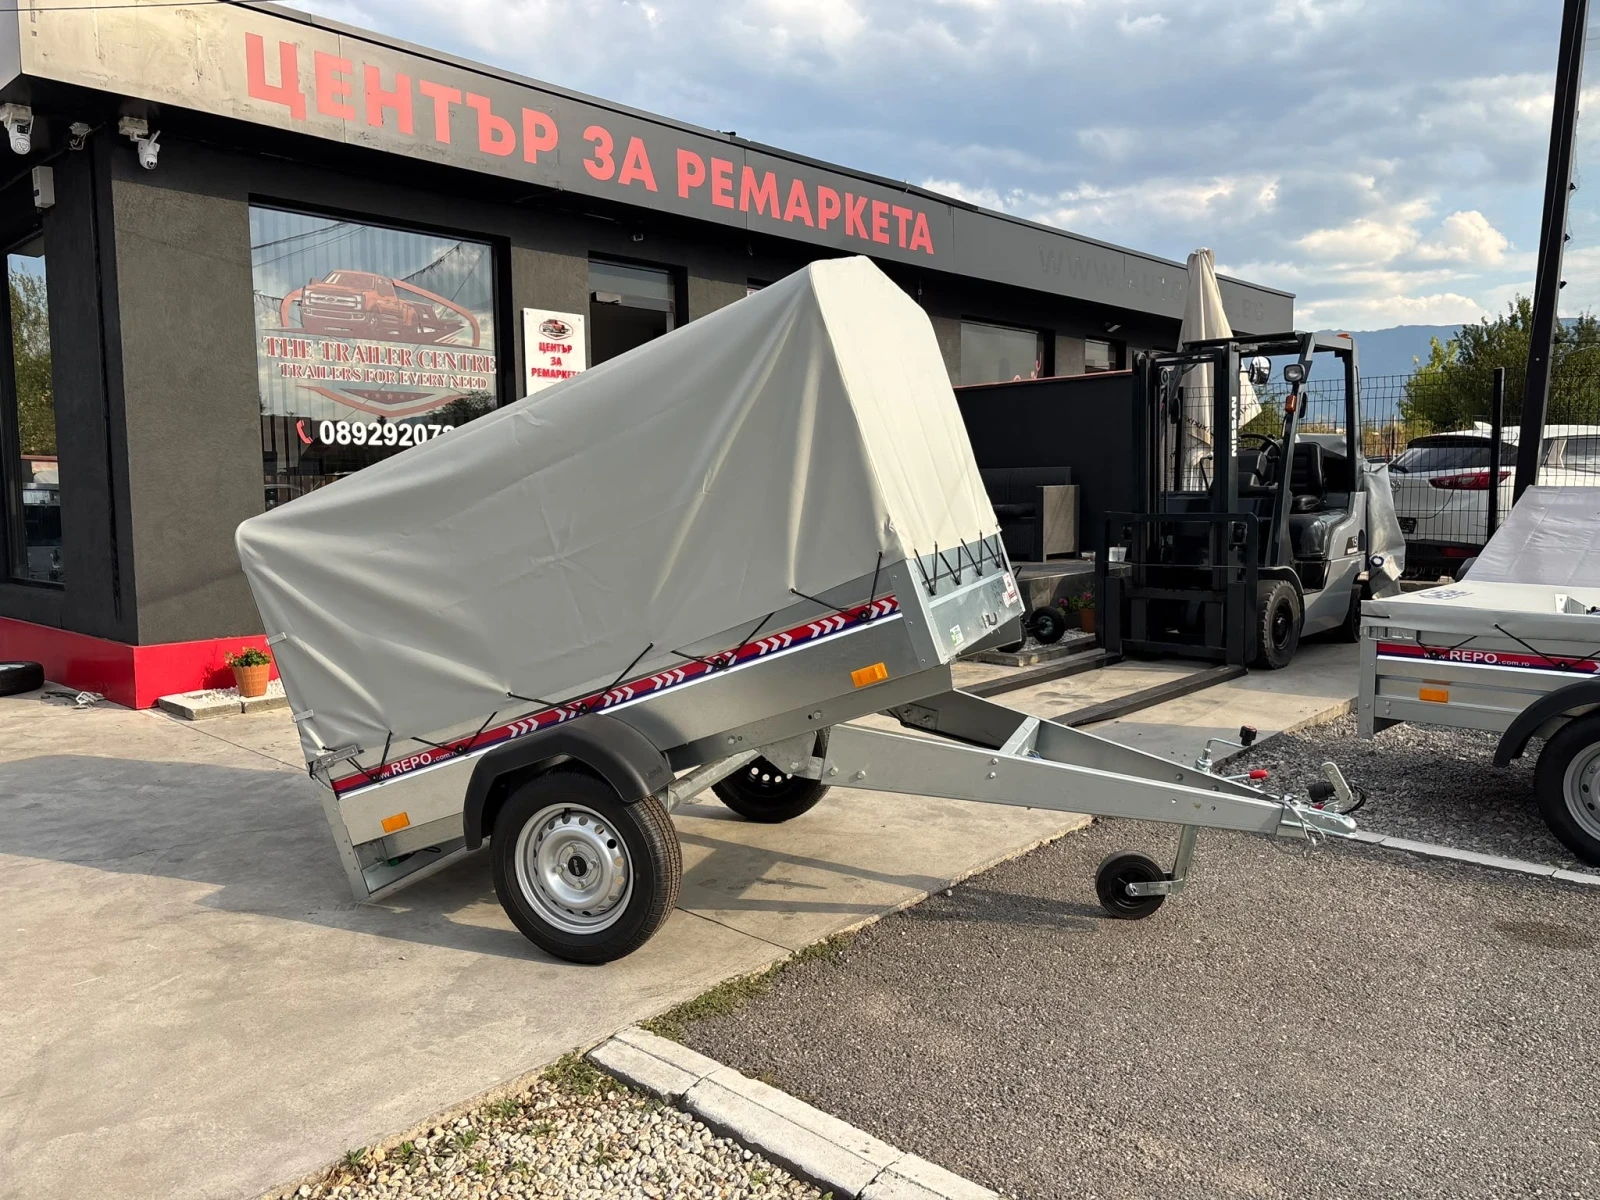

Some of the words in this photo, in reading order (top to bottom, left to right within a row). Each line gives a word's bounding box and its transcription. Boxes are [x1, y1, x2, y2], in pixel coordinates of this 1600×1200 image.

[246, 33, 558, 164] ЦЕНТЪР
[583, 126, 658, 192] ЗА
[677, 149, 934, 255] РЕМАРКЕТА
[263, 336, 314, 359] THE
[319, 340, 414, 367] TRAILER
[417, 349, 497, 374] CENTRE
[539, 342, 572, 353] ЦЕНТЪР
[550, 356, 562, 366] ЗА
[278, 362, 362, 382] TRAILERS
[364, 368, 397, 385] FOR
[399, 371, 447, 388] EVERY
[450, 374, 488, 390] NEED
[531, 367, 581, 379] РЕМАРКЕТ
